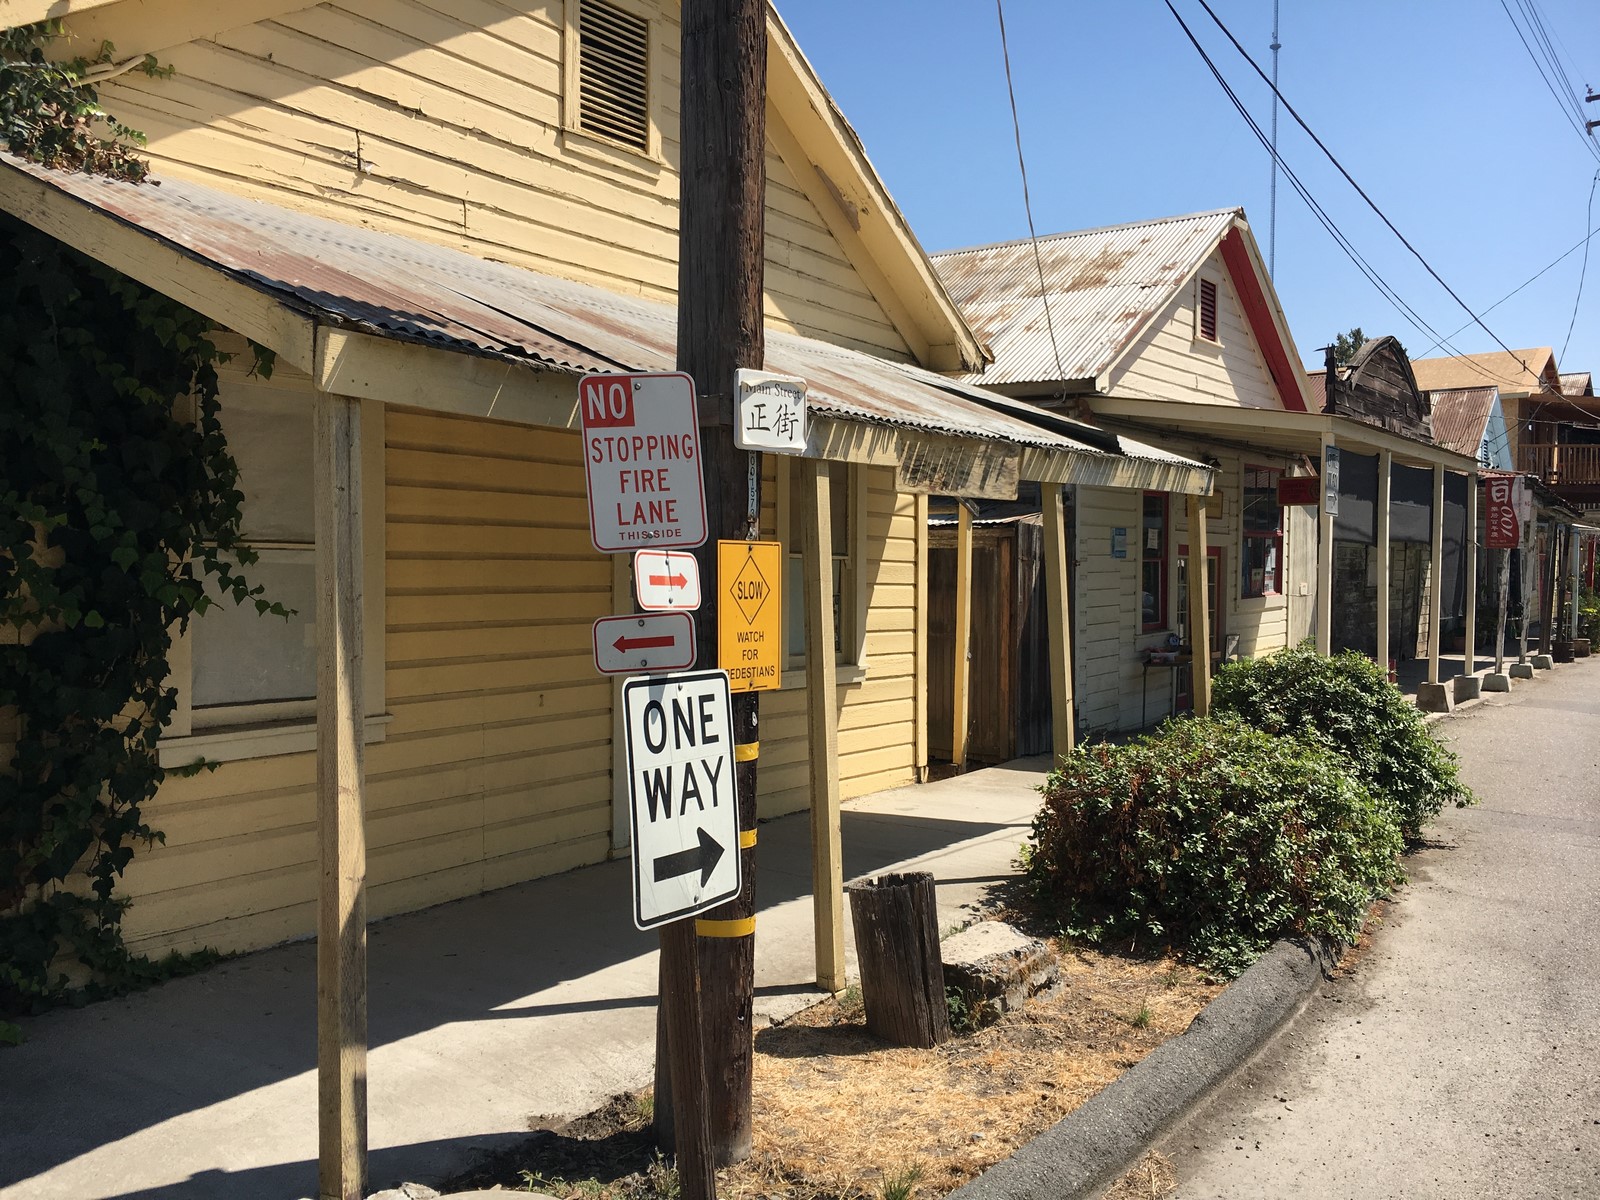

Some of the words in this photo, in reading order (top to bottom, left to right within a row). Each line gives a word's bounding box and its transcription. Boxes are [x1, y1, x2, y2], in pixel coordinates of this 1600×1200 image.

[586, 383, 627, 420] NO
[774, 383, 801, 400] Street
[746, 403, 799, 442] 正街
[591, 434, 694, 463] STOPPING
[619, 468, 671, 494] FIRE
[617, 499, 679, 526] LANE
[1500, 505, 1514, 538] 100
[619, 531, 648, 541] THIS
[653, 528, 682, 538] SIDE
[737, 581, 763, 600] SLOW
[736, 631, 764, 643] WATCH
[742, 649, 759, 661] FOR
[643, 693, 720, 755] ONE
[642, 755, 724, 824] WAY
